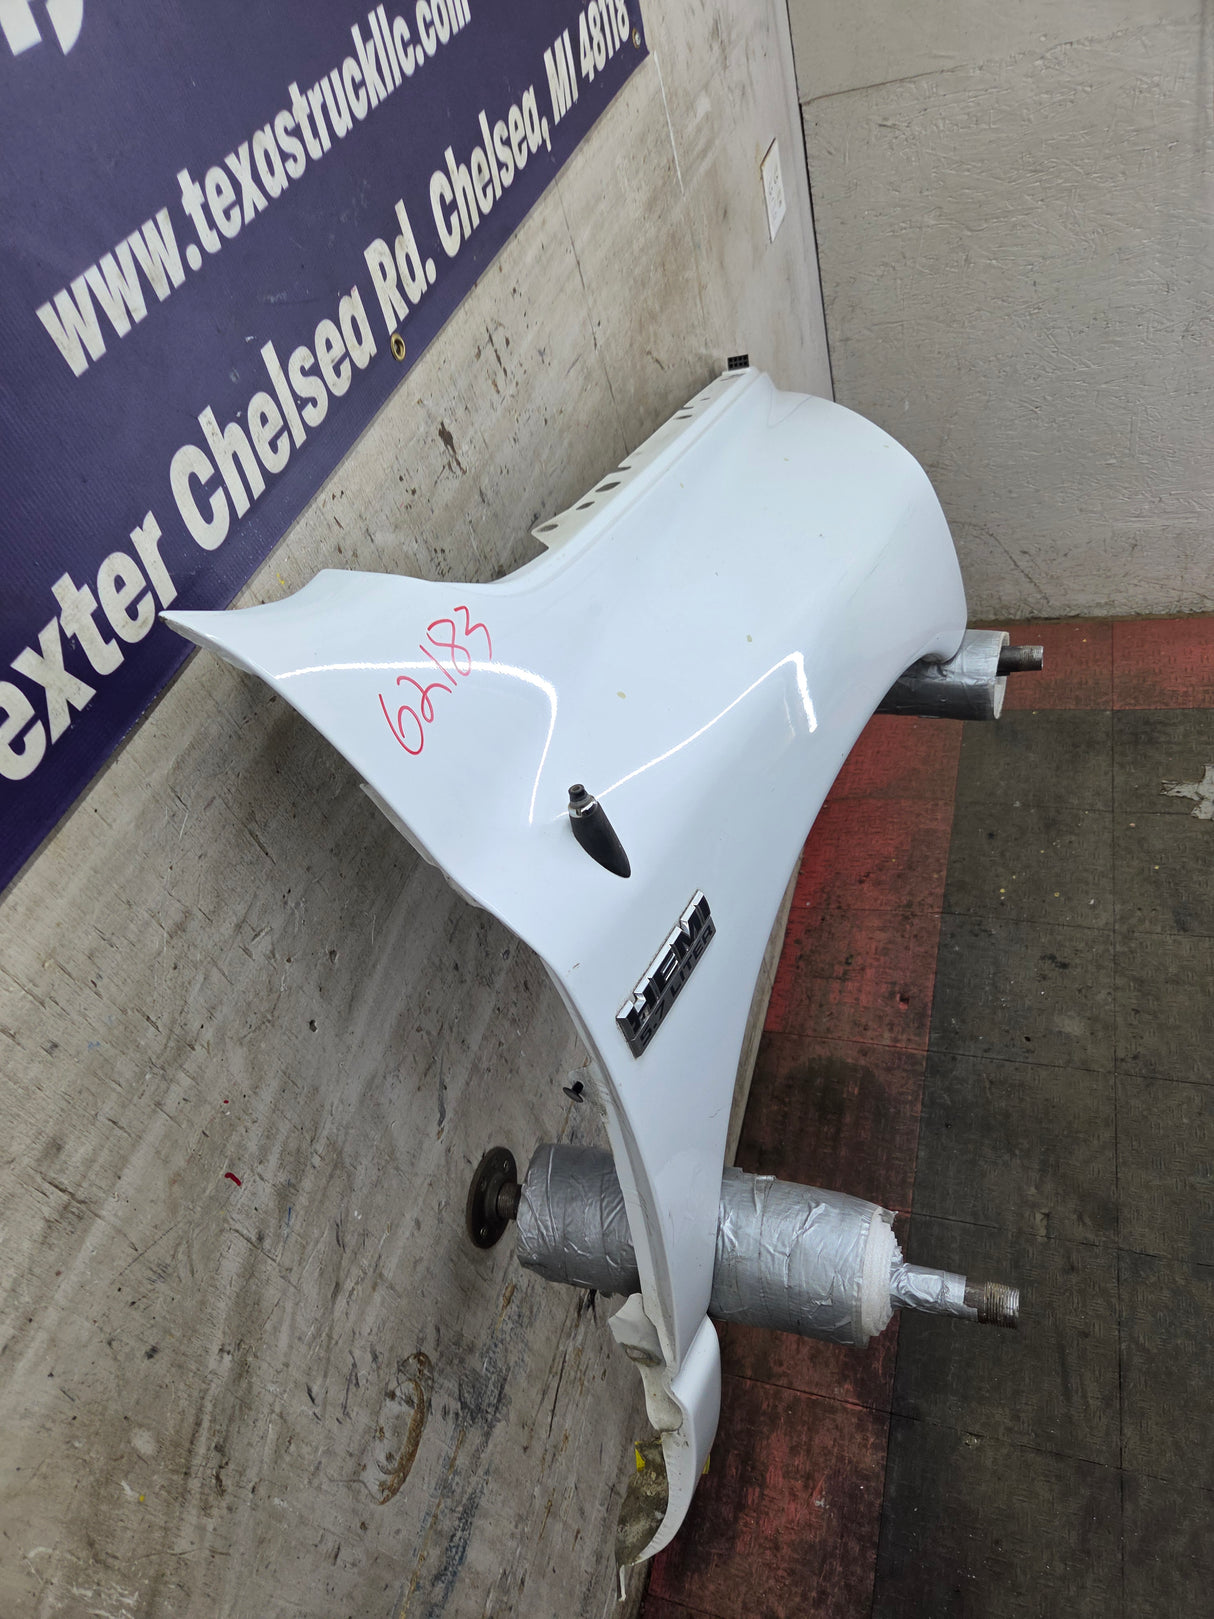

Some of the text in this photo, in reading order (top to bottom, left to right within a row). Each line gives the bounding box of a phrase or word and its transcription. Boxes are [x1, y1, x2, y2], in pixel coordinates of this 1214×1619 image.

[36, 0, 472, 378] www.texastruckllc.com
[170, 286, 377, 551] Chelsea
[364, 199, 437, 335] Rd.
[429, 84, 552, 257] Chelsea,
[543, 27, 579, 126] MI
[579, 0, 630, 83] 48118
[379, 605, 492, 755] 62183
[616, 889, 712, 1041] HEMI
[640, 927, 713, 1048] 5.7 LITER
